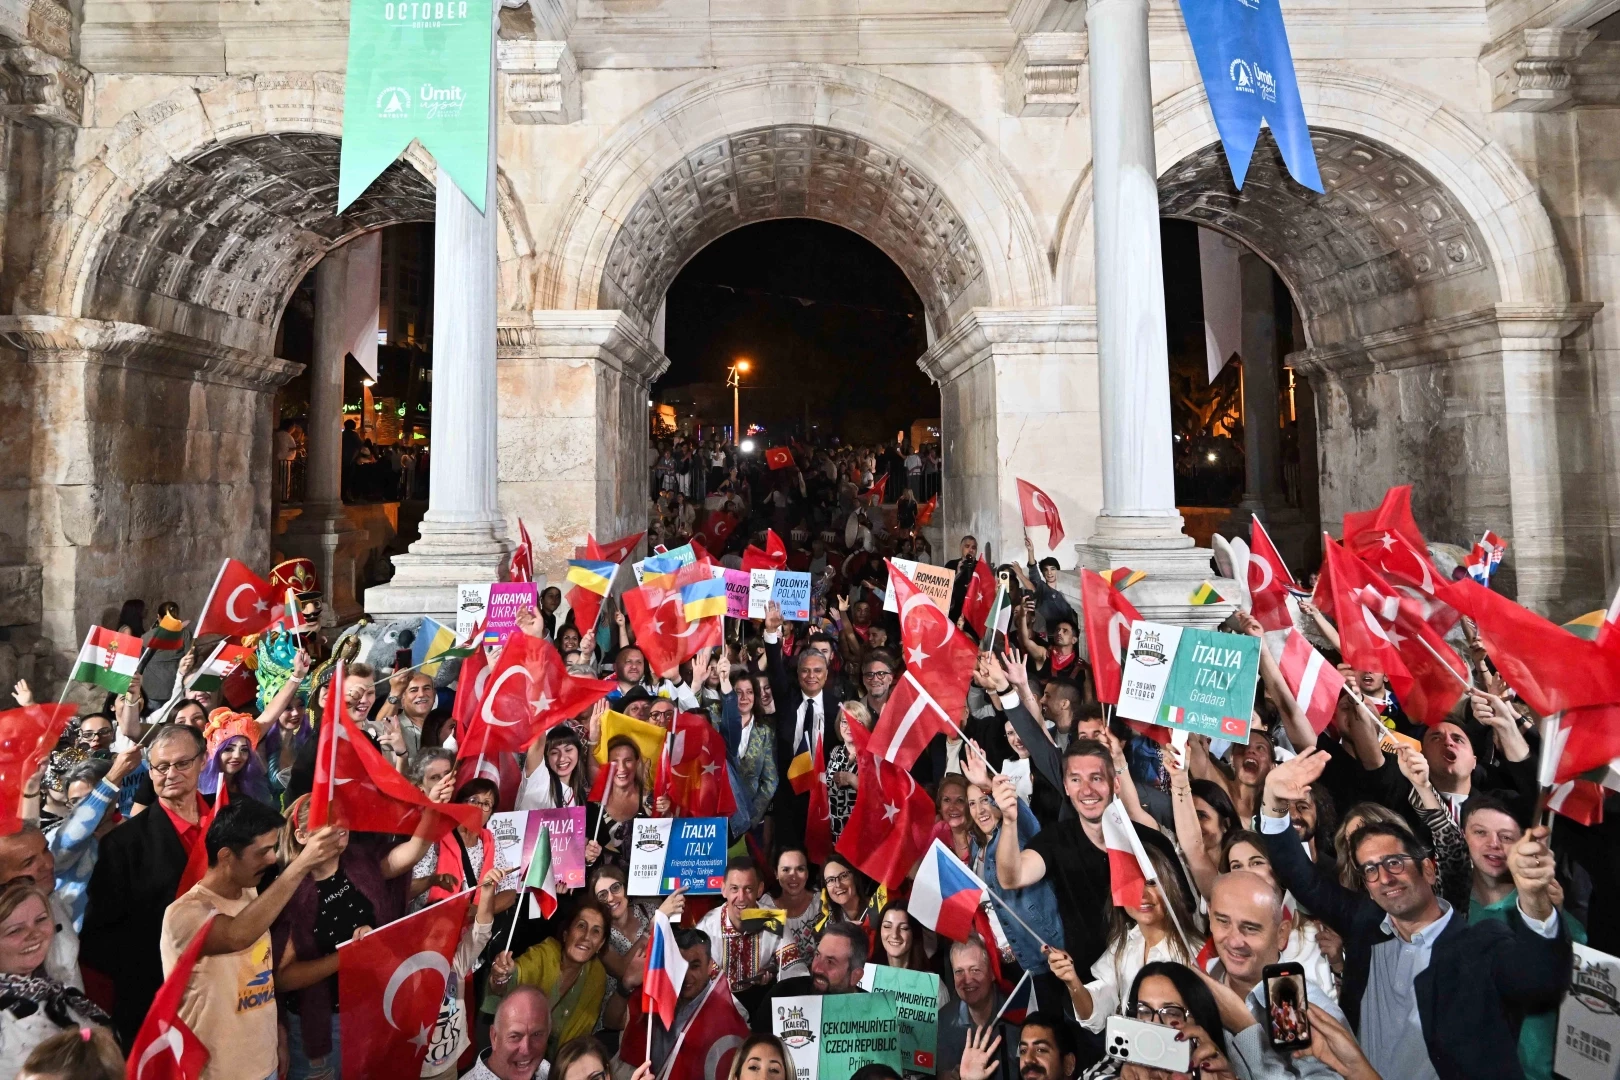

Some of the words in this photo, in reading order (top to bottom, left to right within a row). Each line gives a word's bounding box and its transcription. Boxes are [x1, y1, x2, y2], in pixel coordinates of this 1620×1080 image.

[385, 1, 467, 20] OCTOBER
[1254, 62, 1274, 86] Ümit
[420, 83, 462, 100] Ümit
[726, 582, 750, 594] MOLDOV
[775, 578, 808, 588] POLONYA
[916, 572, 950, 588] ROMANYA
[491, 592, 532, 604] UKRAYNA
[777, 588, 806, 599] POLAND
[491, 606, 534, 618] UKRAE
[1192, 641, 1242, 669] İTALYA
[1194, 668, 1236, 690] ITALY
[1126, 688, 1155, 699] OCTOBER
[1190, 688, 1226, 706] Gradara
[681, 822, 716, 838] İTALYA
[550, 836, 572, 852] ALY
[685, 842, 714, 856] ITALY
[237, 988, 275, 1012] NOMA
[898, 1006, 936, 1024] REPUBLIC
[822, 1022, 839, 1038] ÇEK
[840, 1016, 896, 1034] CUMHURİYETİ
[826, 1039, 854, 1054] CZECH
[854, 1038, 898, 1052] REPUBLIC
[1566, 1034, 1610, 1063] OCTOBER
